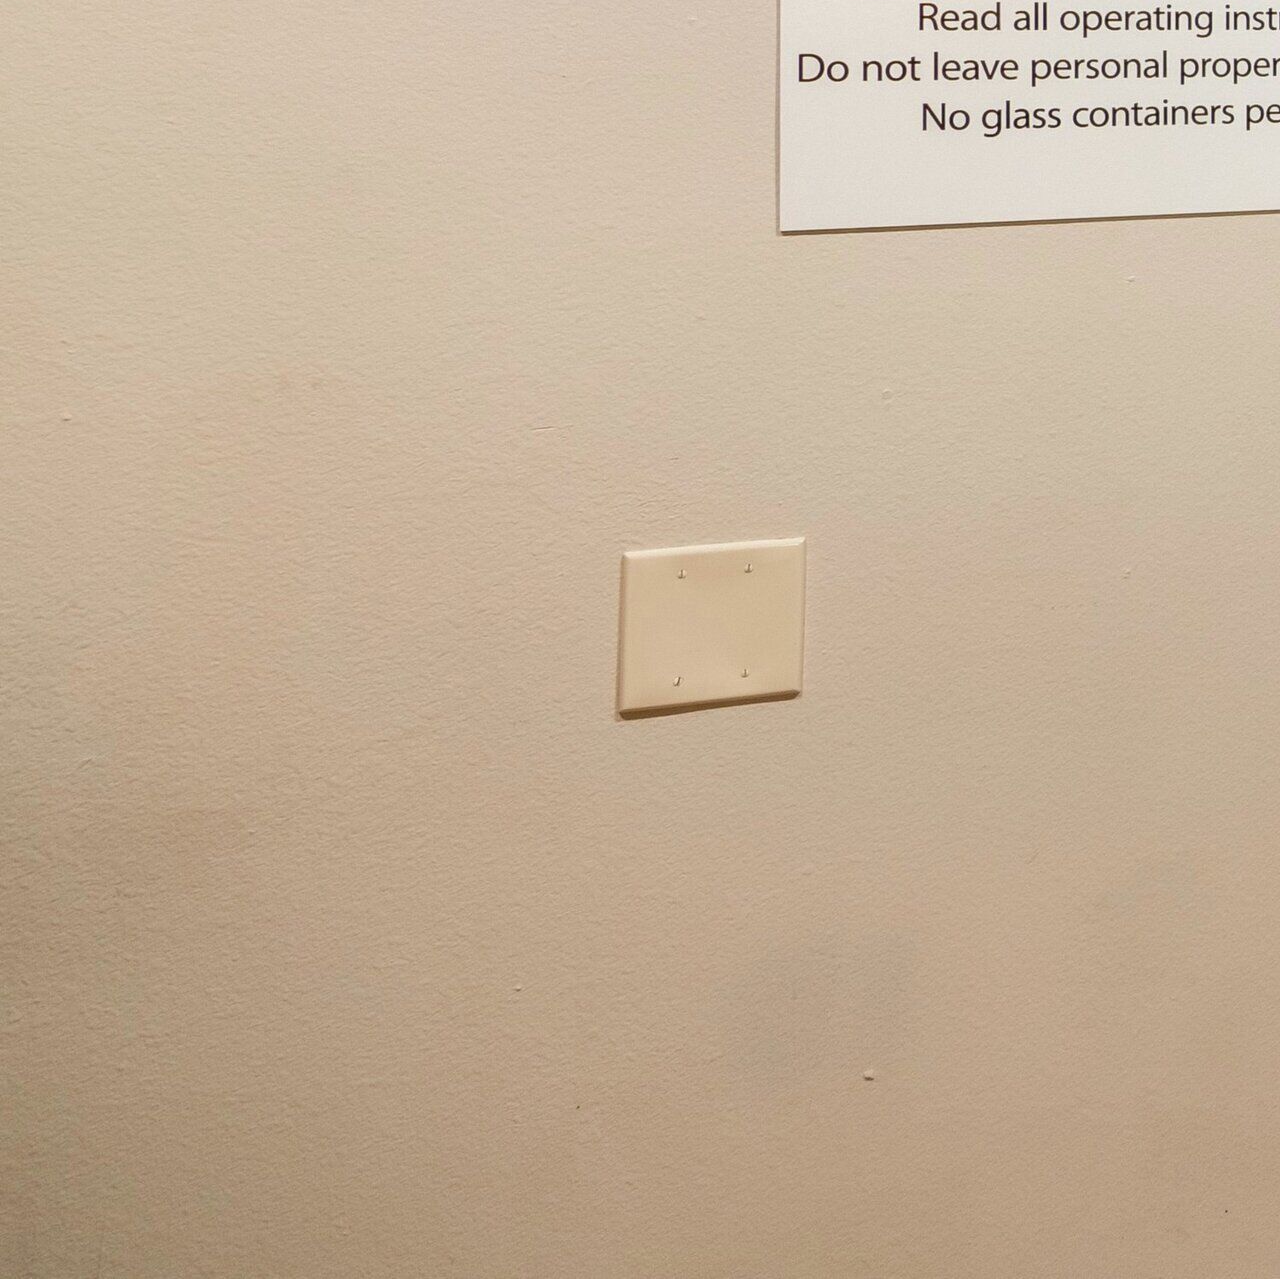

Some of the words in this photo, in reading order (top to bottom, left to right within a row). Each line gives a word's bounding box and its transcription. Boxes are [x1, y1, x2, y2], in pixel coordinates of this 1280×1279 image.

[918, 1, 1001, 31] Read
[1013, 1, 1047, 31] all
[1059, 3, 1213, 38] operating
[798, 53, 849, 82] Do
[862, 56, 921, 81] not
[933, 51, 1018, 81] leave
[1031, 49, 1167, 87] personal
[922, 102, 970, 131] No
[981, 99, 1061, 137] glass
[1072, 98, 1234, 127] containers
